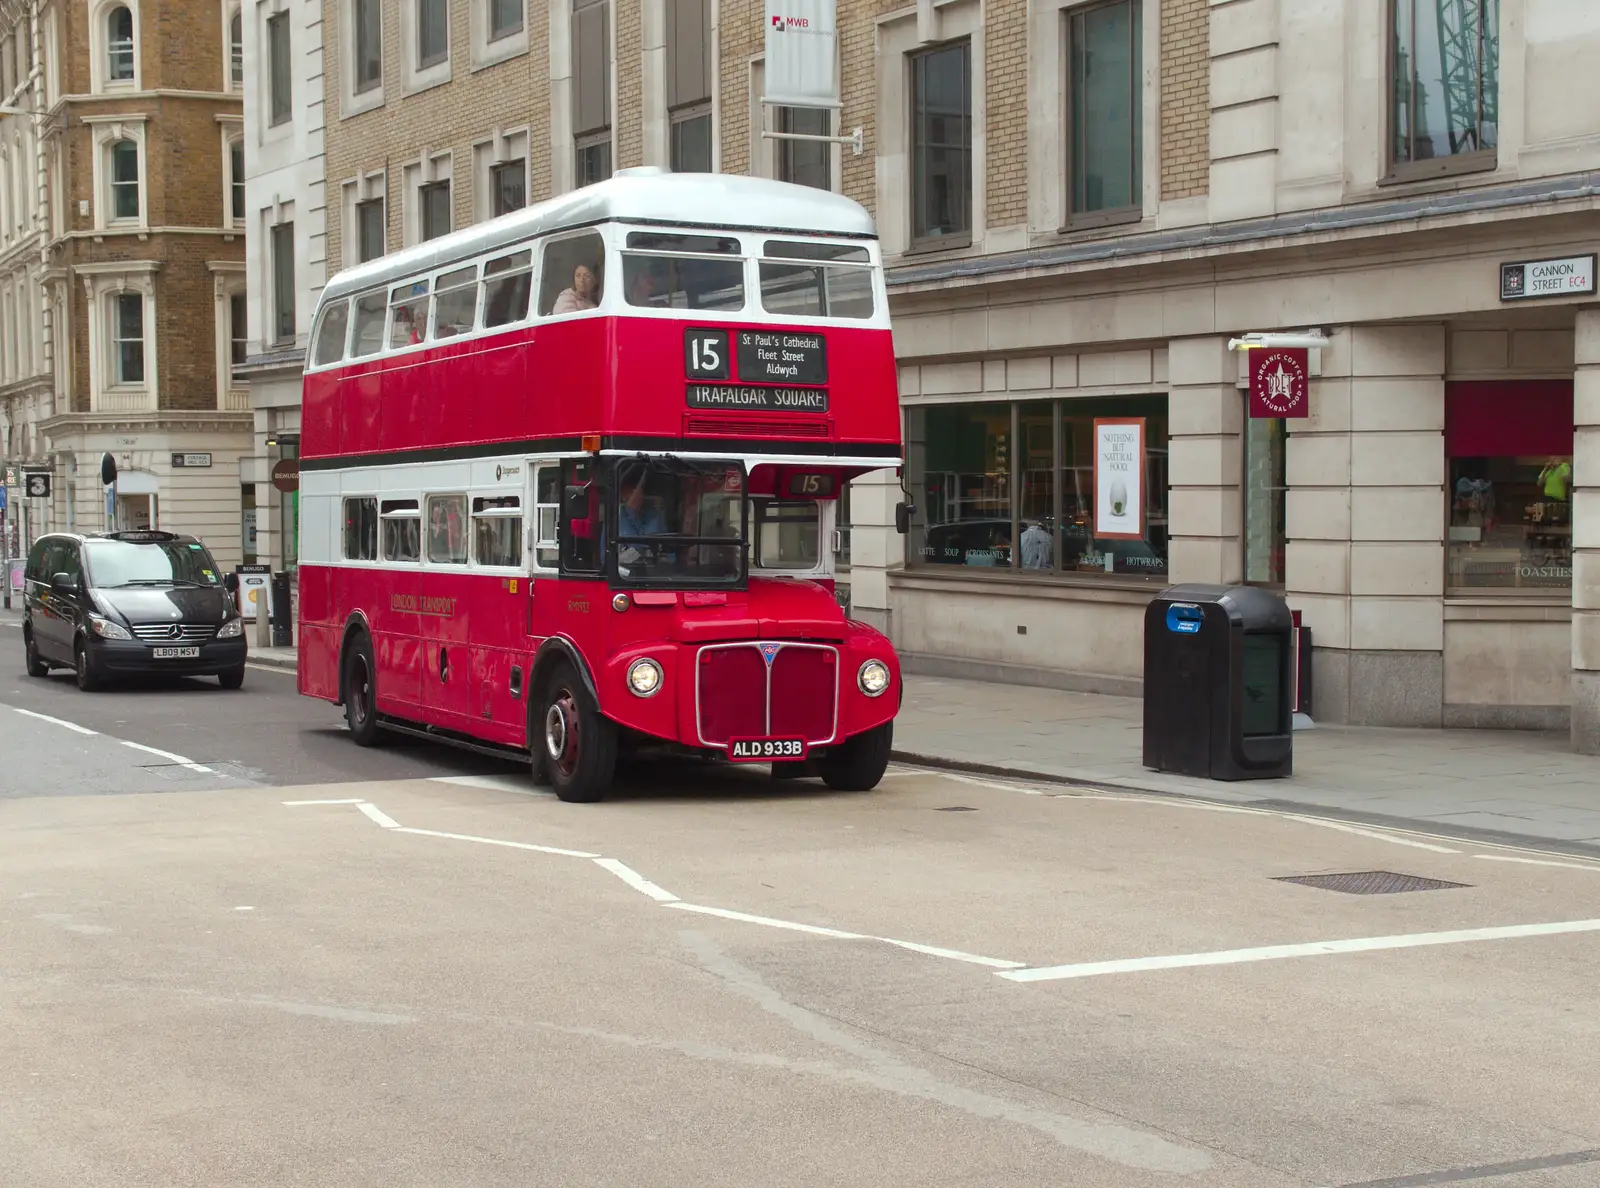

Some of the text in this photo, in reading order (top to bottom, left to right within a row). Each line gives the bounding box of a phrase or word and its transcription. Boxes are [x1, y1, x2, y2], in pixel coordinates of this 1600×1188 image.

[786, 17, 809, 28] MWB
[1532, 263, 1574, 278] CANNON
[1532, 276, 1586, 291] STREET EC4
[742, 333, 820, 350] St Paul's Cathedral
[691, 338, 720, 371] 15
[757, 349, 805, 362] Fleet Street
[766, 363, 798, 378] Aldwych
[1257, 353, 1303, 381] ORGANIC COFFEE
[1268, 372, 1292, 394] PRET
[695, 386, 824, 407] TRAFALGAR SQUARE
[1259, 390, 1302, 412] NATURAL FOOD
[1103, 433, 1135, 443] NOTHING
[1112, 443, 1125, 452] BUT
[1103, 452, 1133, 461] NATURAL
[31, 477, 46, 495] 3
[802, 475, 819, 493] 15
[918, 547, 936, 556] LATTE
[944, 547, 960, 557] SOUP
[1126, 556, 1164, 568] HOTWRAPS
[1512, 566, 1573, 578] TOASTIES
[390, 594, 457, 616] LONDON TRANSPORT
[156, 648, 179, 657] LB09
[733, 741, 802, 757] ALD 933B
